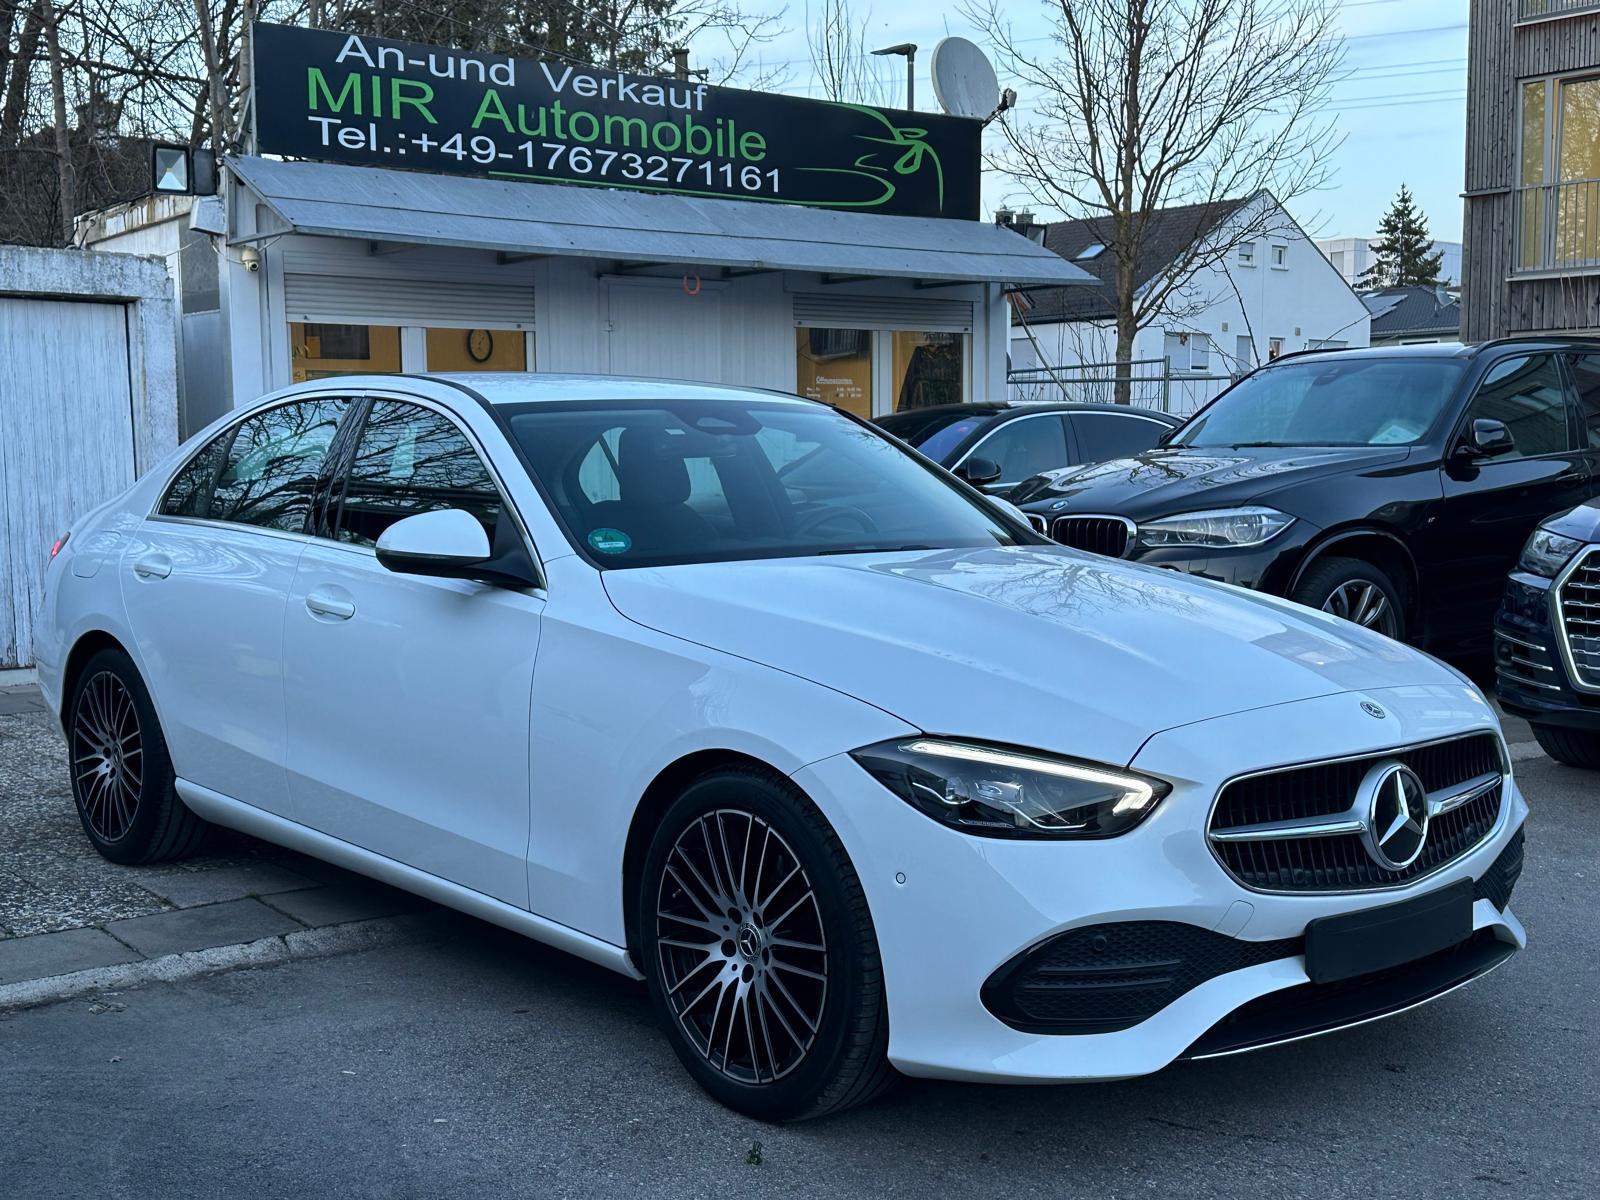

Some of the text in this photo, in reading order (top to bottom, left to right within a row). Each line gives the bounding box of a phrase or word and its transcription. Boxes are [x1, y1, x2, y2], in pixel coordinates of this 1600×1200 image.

[307, 67, 767, 161] MIR Automobile
[335, 35, 708, 111] An-und Verkauf
